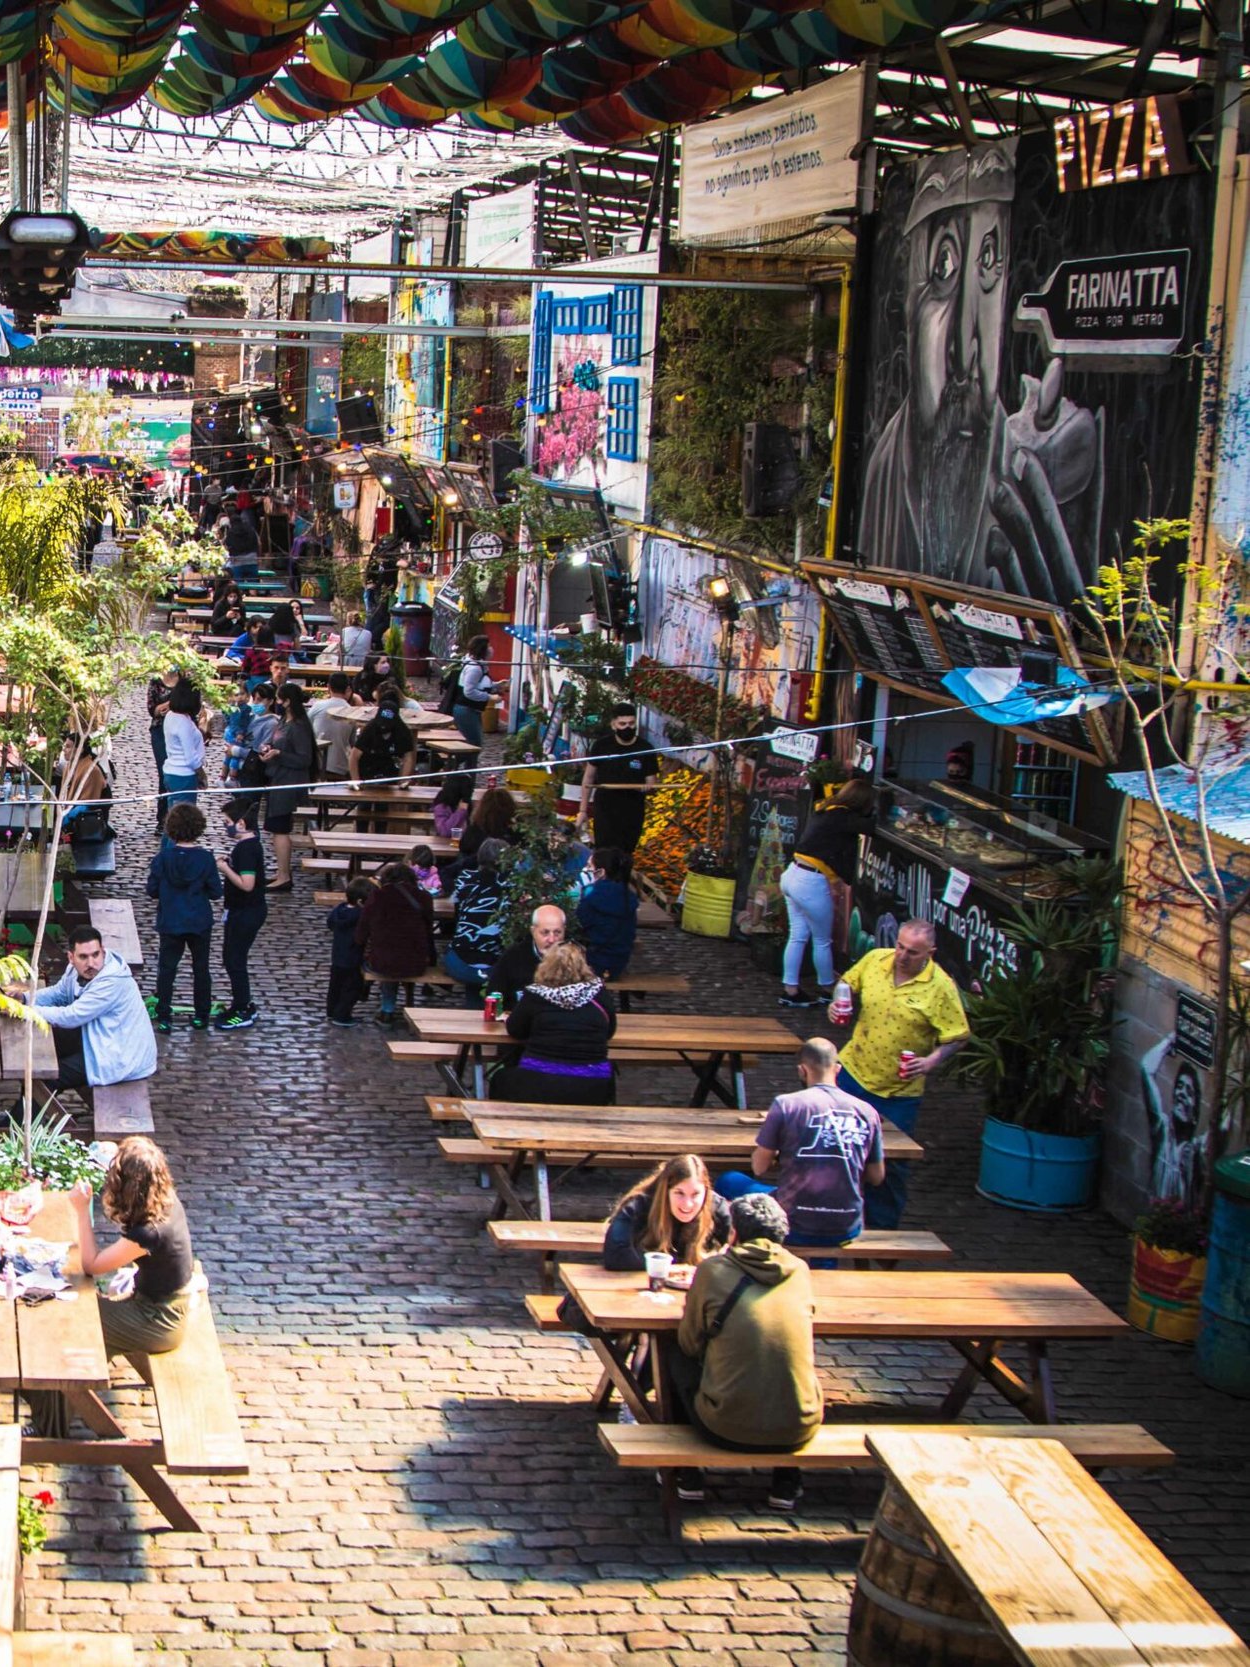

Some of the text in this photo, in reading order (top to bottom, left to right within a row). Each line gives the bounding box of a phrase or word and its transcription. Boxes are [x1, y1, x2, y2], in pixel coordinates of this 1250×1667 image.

[1054, 95, 1170, 193] PIZZA
[704, 179, 715, 195] no
[753, 164, 769, 191] que
[1067, 266, 1179, 309] FARINATTA
[1075, 313, 1164, 328] PIZZA POR METRO
[933, 899, 948, 927] por
[949, 909, 967, 939] una
[966, 904, 1018, 982] Pizza
